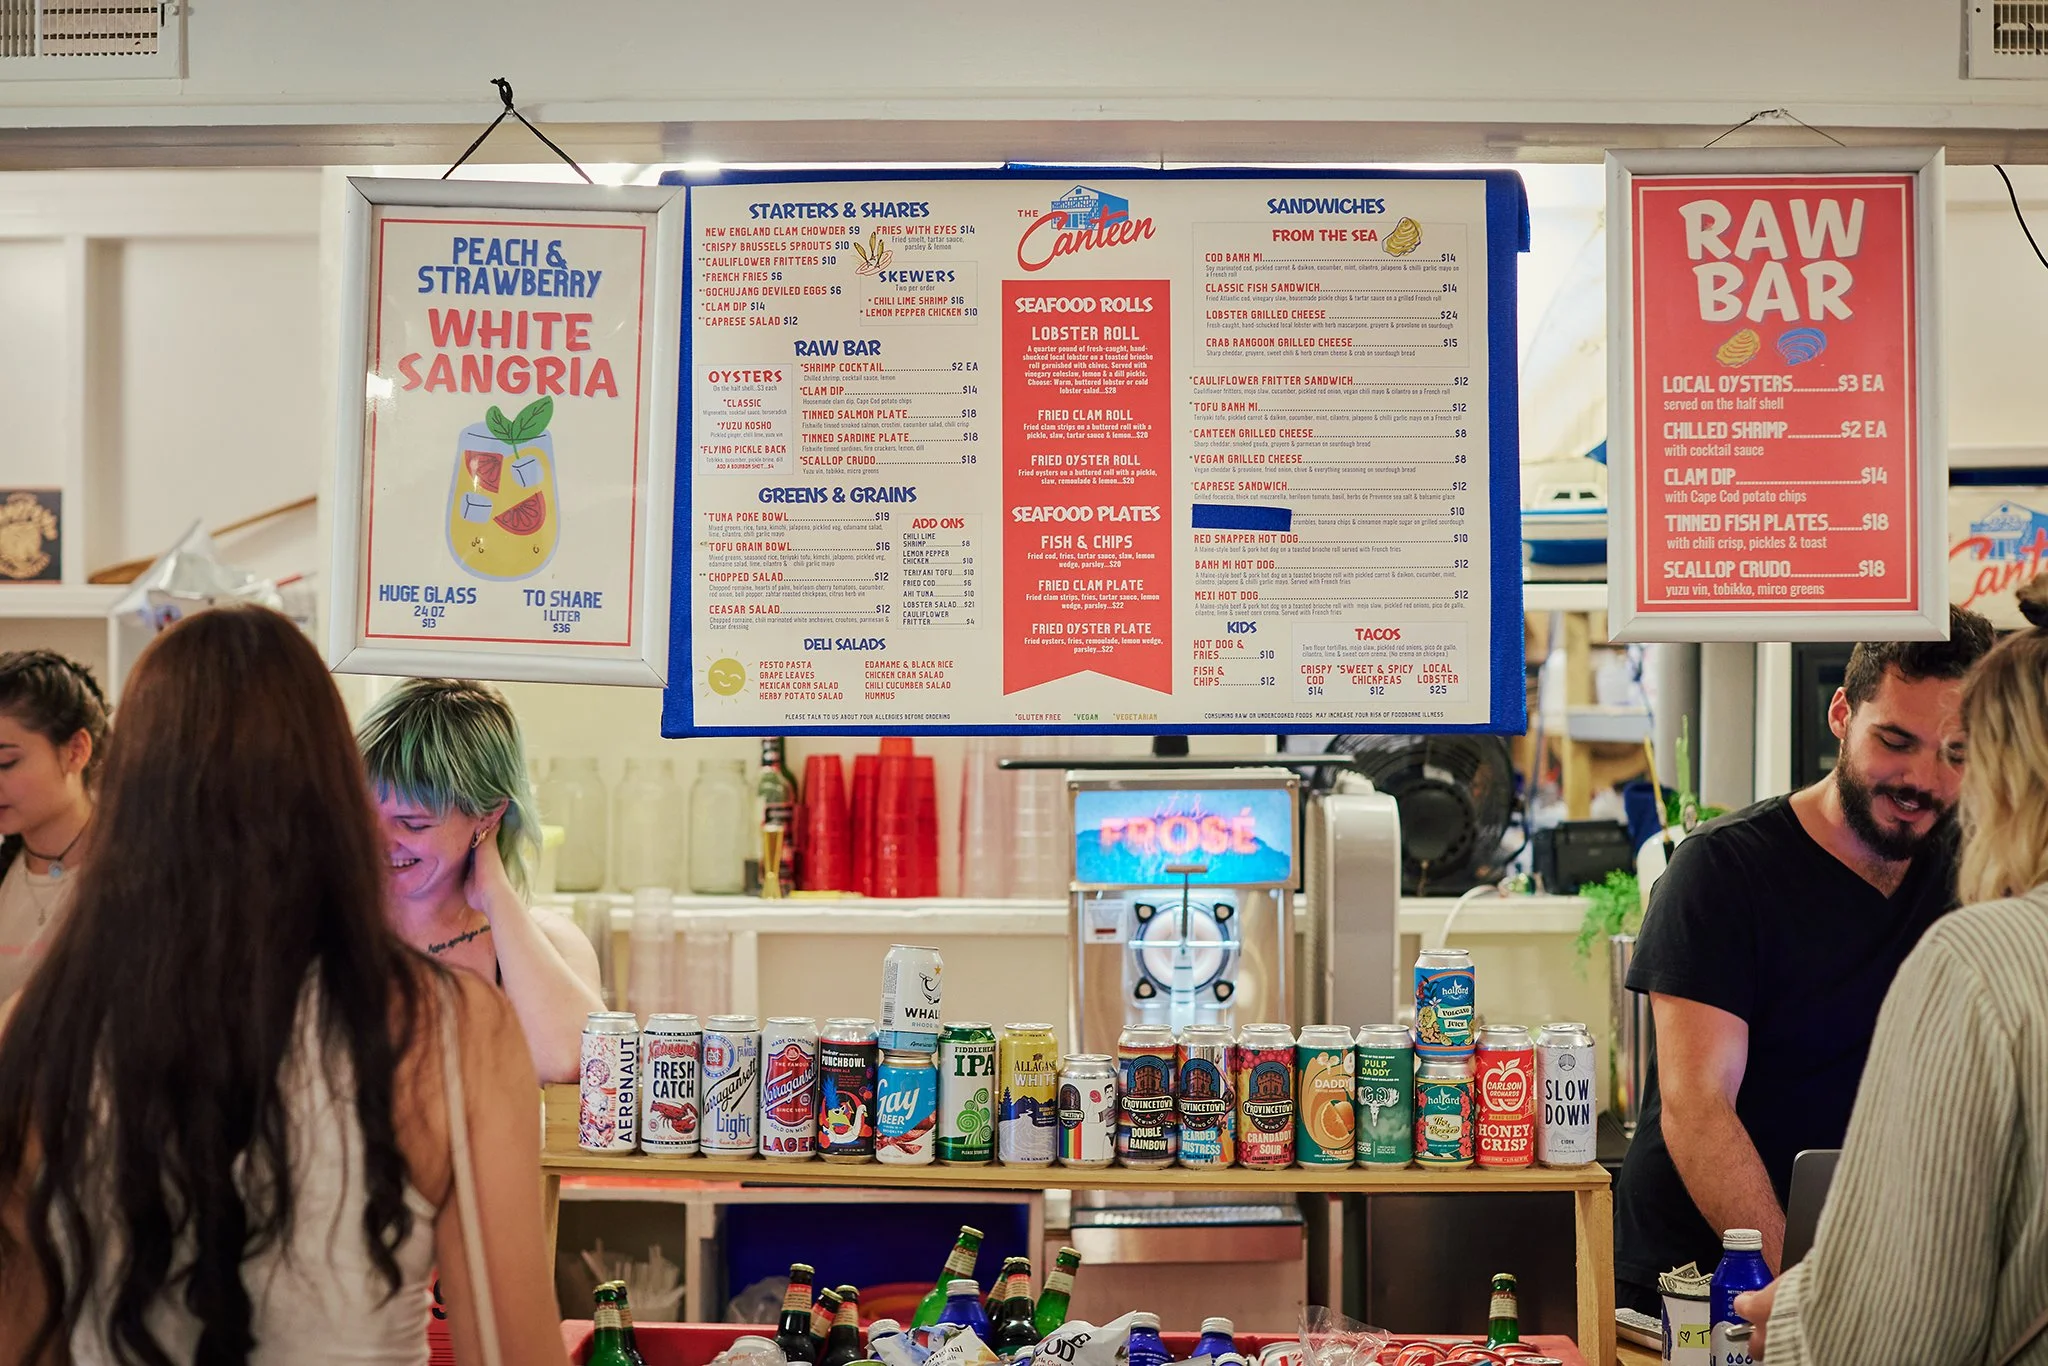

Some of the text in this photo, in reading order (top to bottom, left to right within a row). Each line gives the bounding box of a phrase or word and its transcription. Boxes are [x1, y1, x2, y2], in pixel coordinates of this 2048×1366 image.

[749, 201, 930, 220] STARTERS & SHARES
[1267, 198, 1386, 214] SANDWICHES
[1017, 209, 1039, 218] THE
[705, 225, 860, 237] NEW ENGLAND CLAM CHOWDER $9
[876, 225, 975, 235] FRIES WITH EYES $14
[1272, 229, 1378, 242] FROM THE SEA
[1678, 197, 1865, 262] RAW
[1017, 203, 1156, 272] Canteen
[453, 237, 568, 270] PEACH &
[418, 267, 601, 299] STRAWBERRY
[878, 270, 956, 283] SKEWERS
[1693, 260, 1855, 323] BAR
[874, 296, 964, 306] CHILI LIME SHRIMP $16
[1014, 297, 1153, 313] SEAFOOD ROLLS
[866, 307, 978, 317] LEMON PEPPER CHICKEN $10
[1206, 310, 1326, 319] LOBSTER GRILLED CHEESE
[428, 308, 593, 352] WHITE
[1032, 326, 1140, 341] LOBSTER ROLL
[794, 339, 882, 356] RAW BAR
[398, 352, 619, 398] SANGRIA
[708, 369, 783, 383] OYSTERS
[1663, 375, 1714, 393] LOCAL
[1862, 374, 1884, 392] EA
[1664, 397, 1784, 411] served on the half shell
[1038, 409, 1133, 421] FRIED CLAM ROLL
[1664, 421, 1727, 439] CHILLED
[1865, 421, 1887, 438] EA
[1664, 443, 1764, 457] with cocktail sauce
[1031, 455, 1140, 466] FRIED OYSTER ROLL
[1664, 468, 1708, 486] CLAM
[758, 486, 917, 503] GREENS & GRAINS
[1665, 490, 1807, 505] with Cape Cod potato chips
[1012, 506, 1161, 522] SEAFOOD PLATES
[912, 518, 965, 529] ADD ONS
[1665, 514, 1760, 532] TINNED FISH
[1041, 535, 1133, 549] FISH & CHIPS
[1667, 536, 1827, 552] with chili crisp, pickles & toast
[1664, 561, 1735, 578] SCALLOP
[1038, 579, 1144, 591] FRIED CLAM PLATE
[1666, 583, 1824, 598] yuzu vin, tobikko, mirco greens
[379, 584, 477, 605] HUGE GLASS
[523, 590, 602, 609] TO SHARE
[414, 605, 445, 618] 24 OZ
[550, 609, 581, 622] LITER
[422, 618, 436, 629] $13
[553, 623, 570, 634] $36
[1032, 623, 1152, 634] FRIED OYSTER PLATE
[1227, 622, 1257, 633] KIDS
[1355, 628, 1401, 640] TACOS
[804, 638, 886, 650] DELI SALADS
[760, 661, 812, 669] PESTO PASTA
[760, 671, 815, 680] GRAPE LEAVES
[865, 692, 895, 700] HUMMUS
[822, 1056, 865, 1068] PUNCHBOWL
[954, 1054, 995, 1076] IPA
[1365, 1060, 1387, 1068] PULP
[654, 1061, 695, 1079] FRESH
[1362, 1068, 1390, 1076] DADDY
[1013, 1073, 1056, 1087] WHITE
[1487, 1082, 1522, 1090] CARLSON
[618, 1038, 634, 1143] AERONAUT
[653, 1080, 694, 1098] CATCH
[1546, 1079, 1589, 1101] SLOW
[877, 1079, 920, 1125] Gay
[882, 1115, 905, 1125] BEER
[1546, 1104, 1590, 1125] DOWN
[717, 1108, 752, 1140] Light
[1479, 1124, 1529, 1136] HONEY
[1132, 1127, 1162, 1138] DOUBLE
[1183, 1130, 1216, 1141] BEARDED
[763, 1135, 817, 1152] LAGER
[1130, 1138, 1167, 1150] RAINBOW
[1182, 1142, 1221, 1154] MISTRESS
[1260, 1144, 1282, 1154] SOUR
[1481, 1139, 1527, 1151] CRISP
